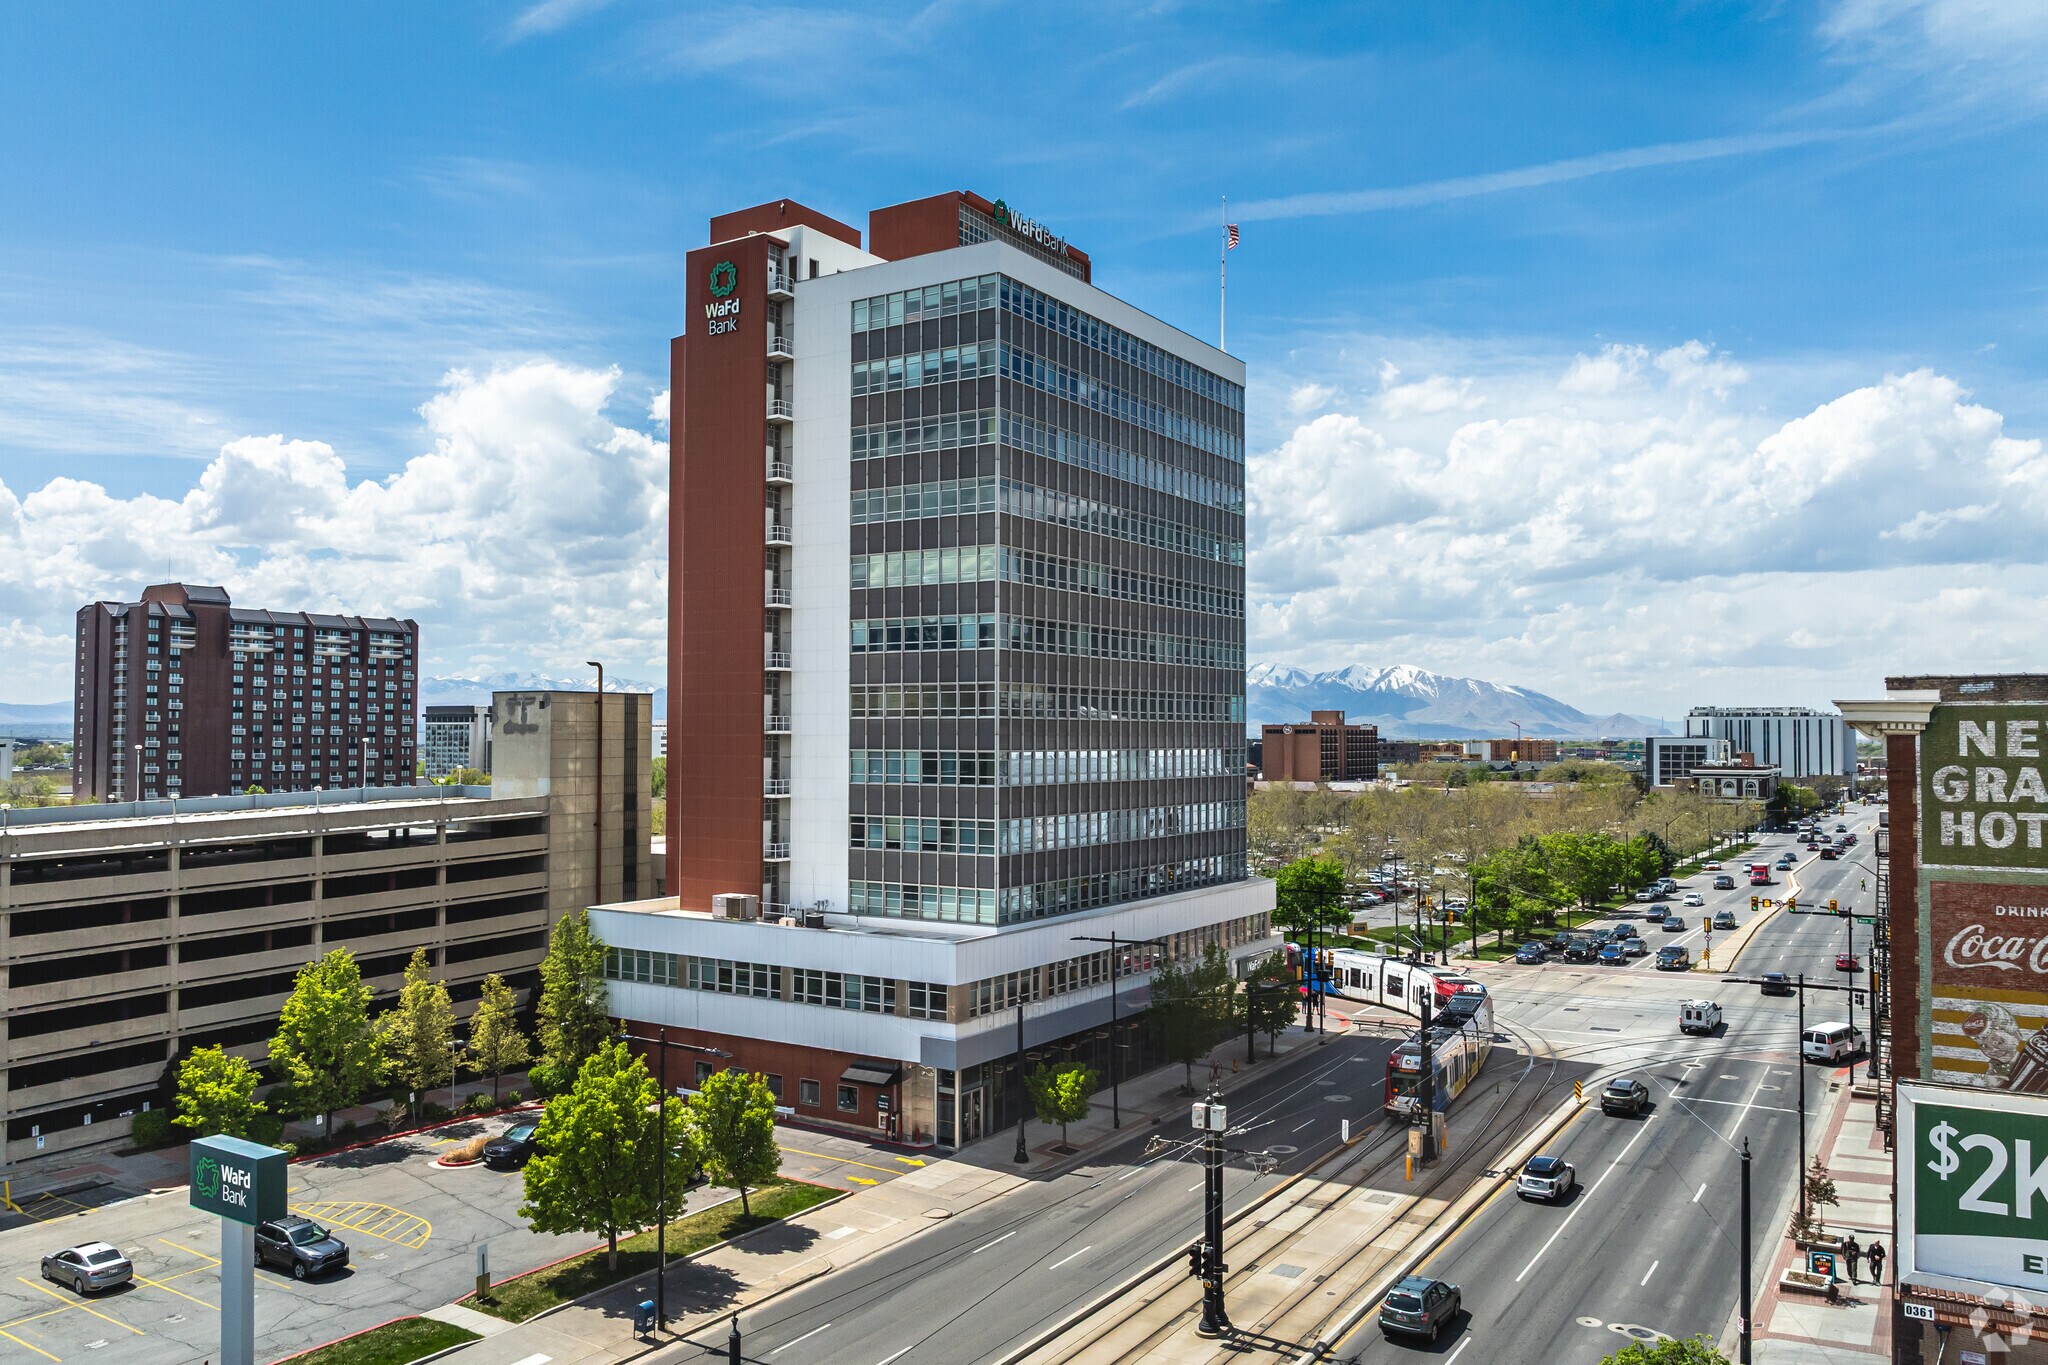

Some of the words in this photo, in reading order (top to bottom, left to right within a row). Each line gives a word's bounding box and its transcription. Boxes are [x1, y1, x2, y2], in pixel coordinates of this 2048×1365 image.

[1009, 207, 1043, 243] WaFd
[1043, 225, 1069, 257] Bank
[705, 298, 740, 319] WaFd
[709, 317, 737, 335] Bank
[1958, 720, 2048, 757] NE
[1932, 765, 2048, 803] GRA
[1940, 811, 2048, 849] HOT
[1995, 905, 2048, 917] DRINK
[221, 1164, 251, 1189] WaFd
[222, 1185, 247, 1208] Bank
[2022, 1253, 2048, 1275] E
[1906, 1305, 1933, 1319] 0361
